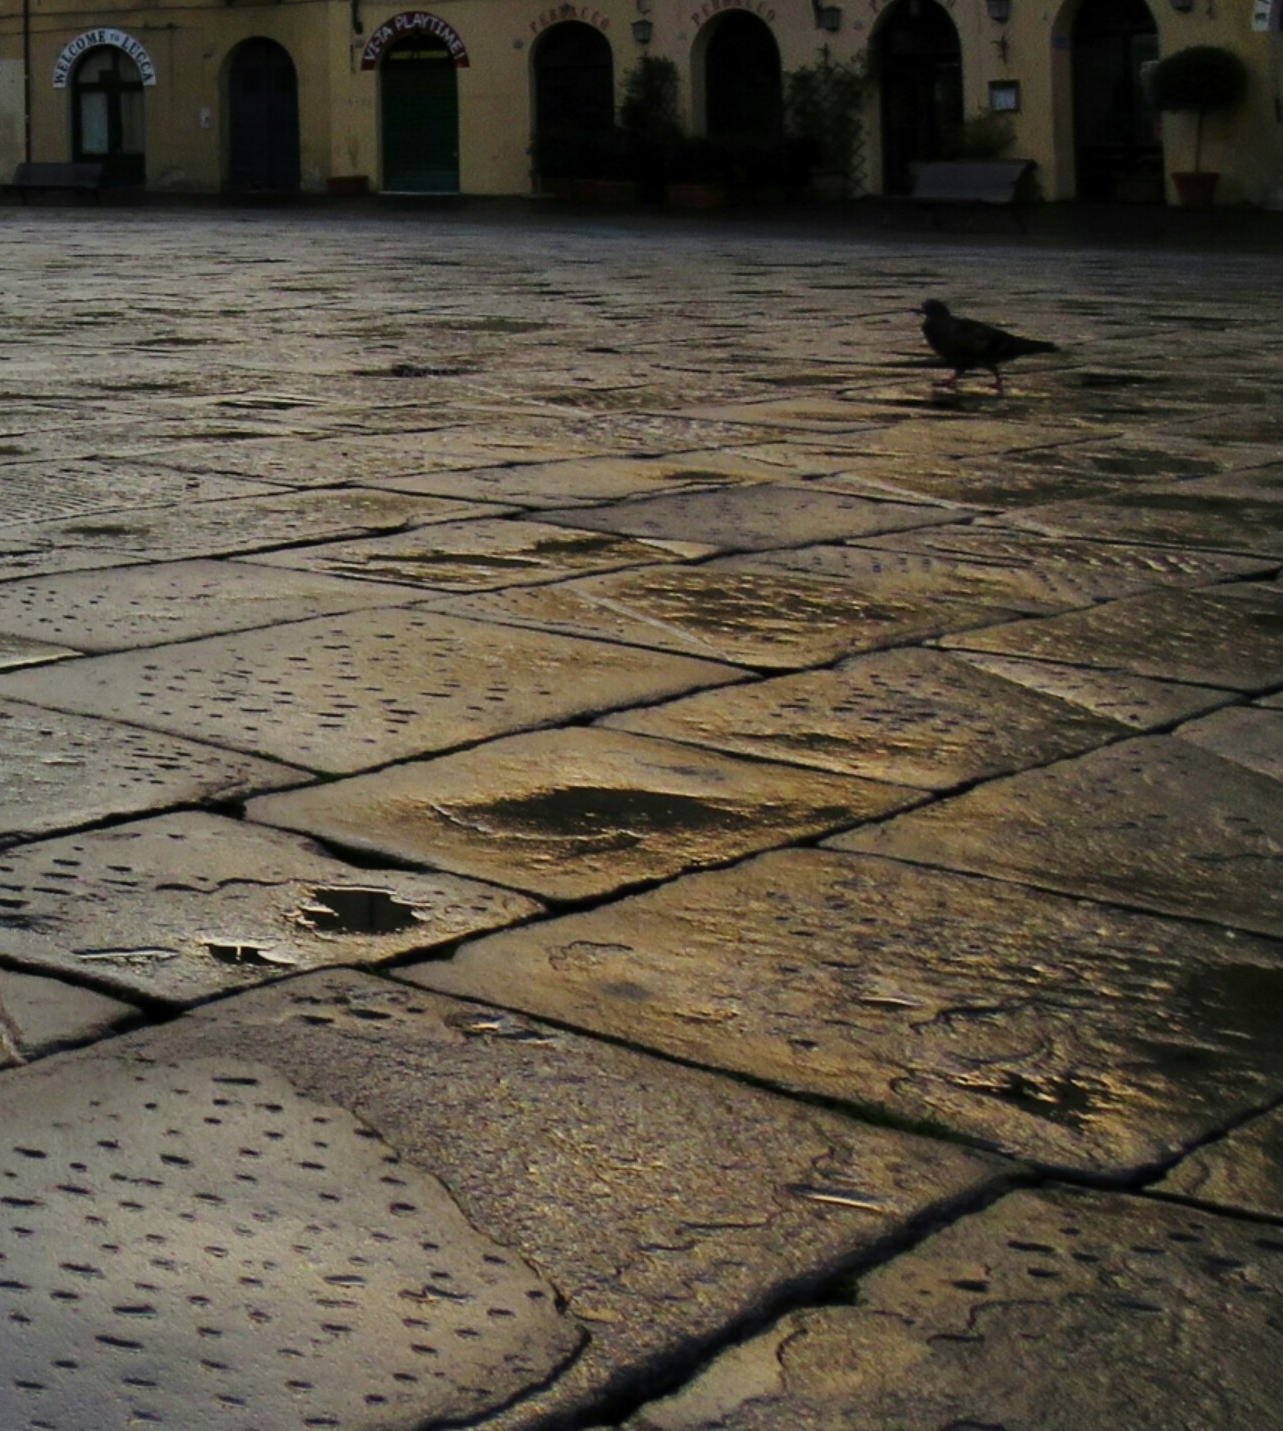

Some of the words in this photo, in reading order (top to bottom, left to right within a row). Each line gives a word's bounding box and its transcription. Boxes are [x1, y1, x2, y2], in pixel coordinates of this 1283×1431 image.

[54, 31, 105, 84] WELCOME
[122, 37, 153, 82] LUCCA
[395, 14, 465, 60] PLAYTIME!
